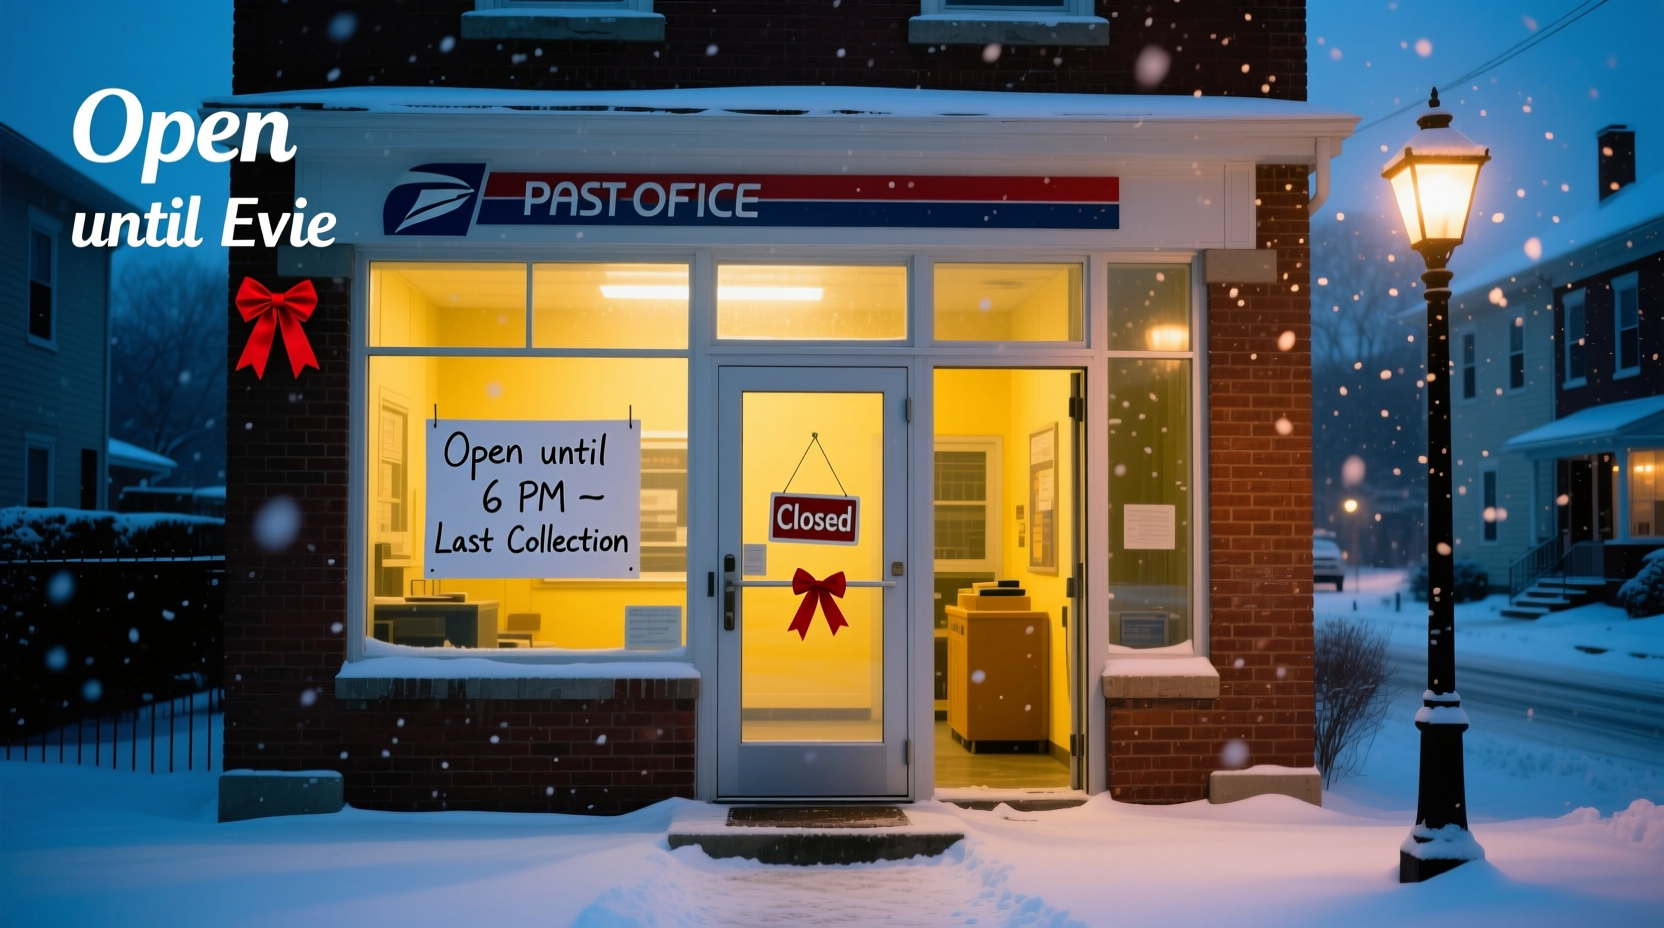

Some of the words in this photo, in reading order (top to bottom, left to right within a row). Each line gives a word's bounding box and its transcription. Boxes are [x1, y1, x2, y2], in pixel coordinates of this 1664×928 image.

[523, 181, 627, 217] PAST
[633, 181, 762, 217] OFICE
[444, 430, 523, 481] Open
[540, 432, 607, 466] until
[482, 478, 503, 514] 6
[518, 479, 566, 513] PM
[777, 503, 852, 532] Closed
[434, 521, 495, 554] Last
[507, 523, 629, 554] Collection
